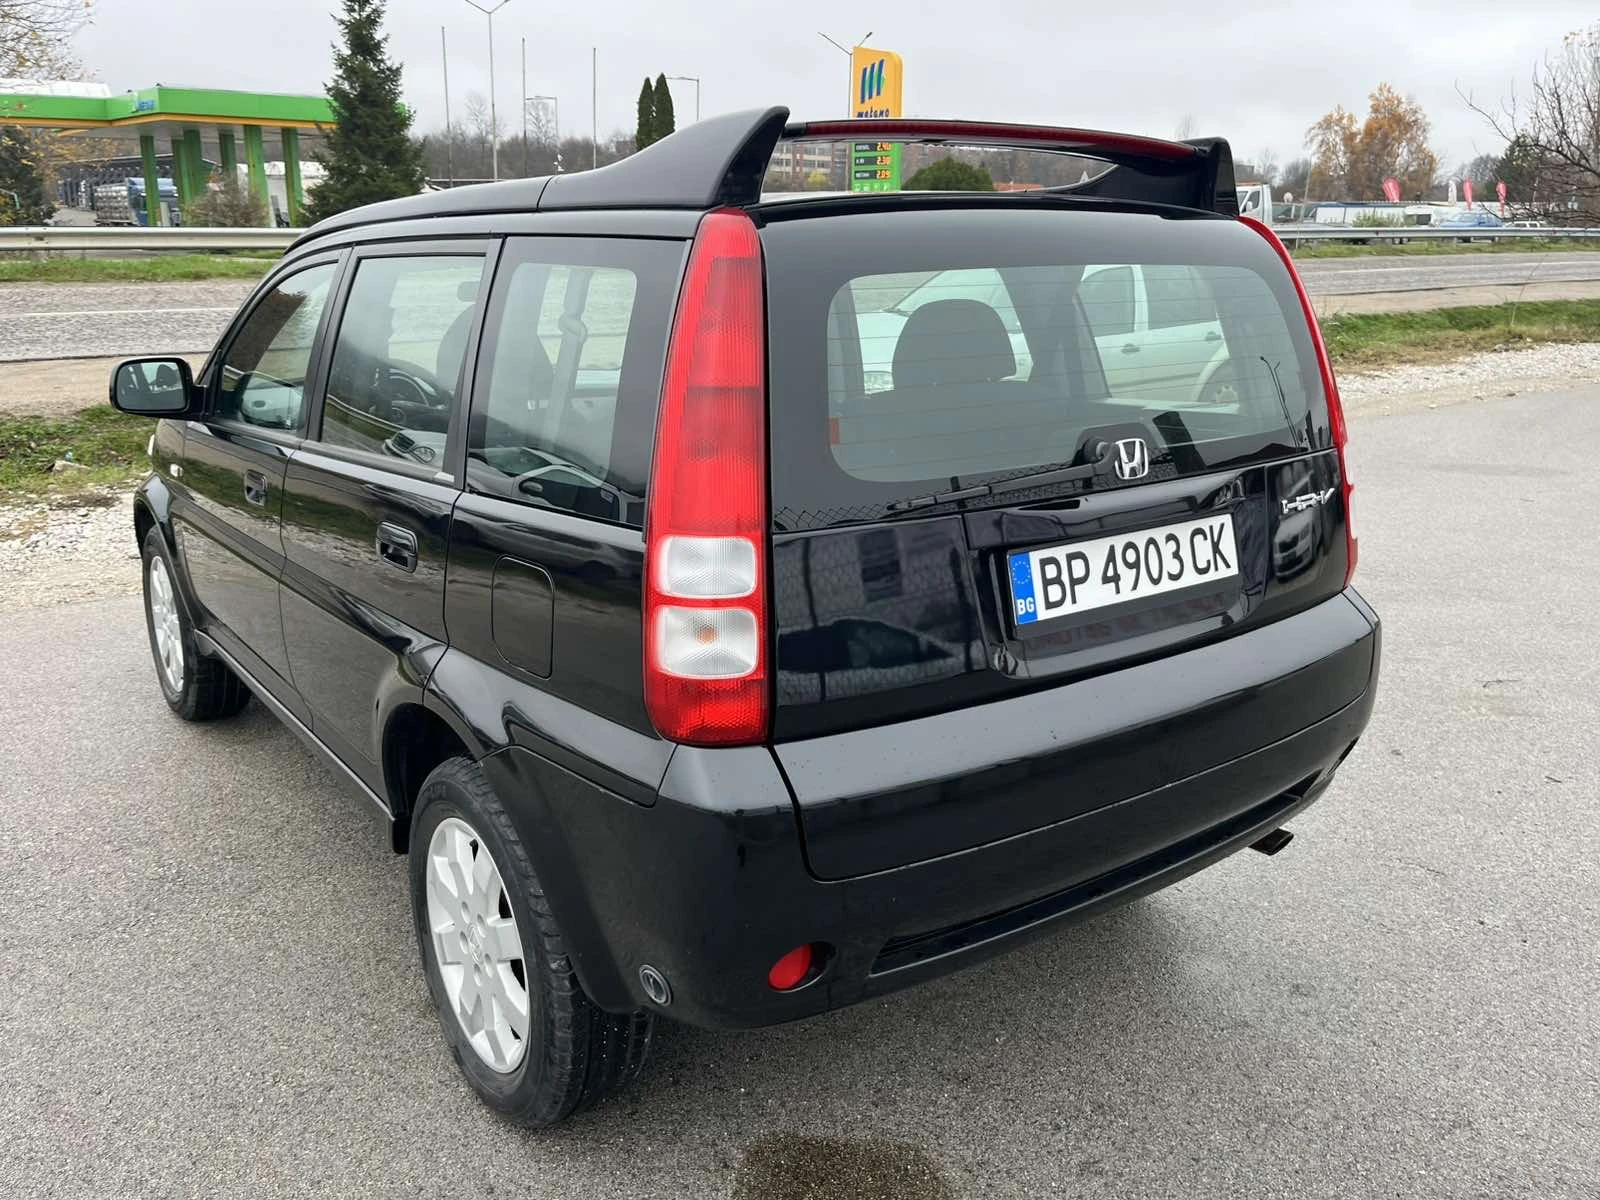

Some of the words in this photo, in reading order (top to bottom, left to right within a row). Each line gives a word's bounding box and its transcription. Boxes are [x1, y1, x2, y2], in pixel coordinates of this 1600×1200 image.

[1039, 551, 1090, 611] BP
[1101, 533, 1185, 595] 4903
[1189, 522, 1232, 575] CK
[1017, 598, 1035, 616] BG
